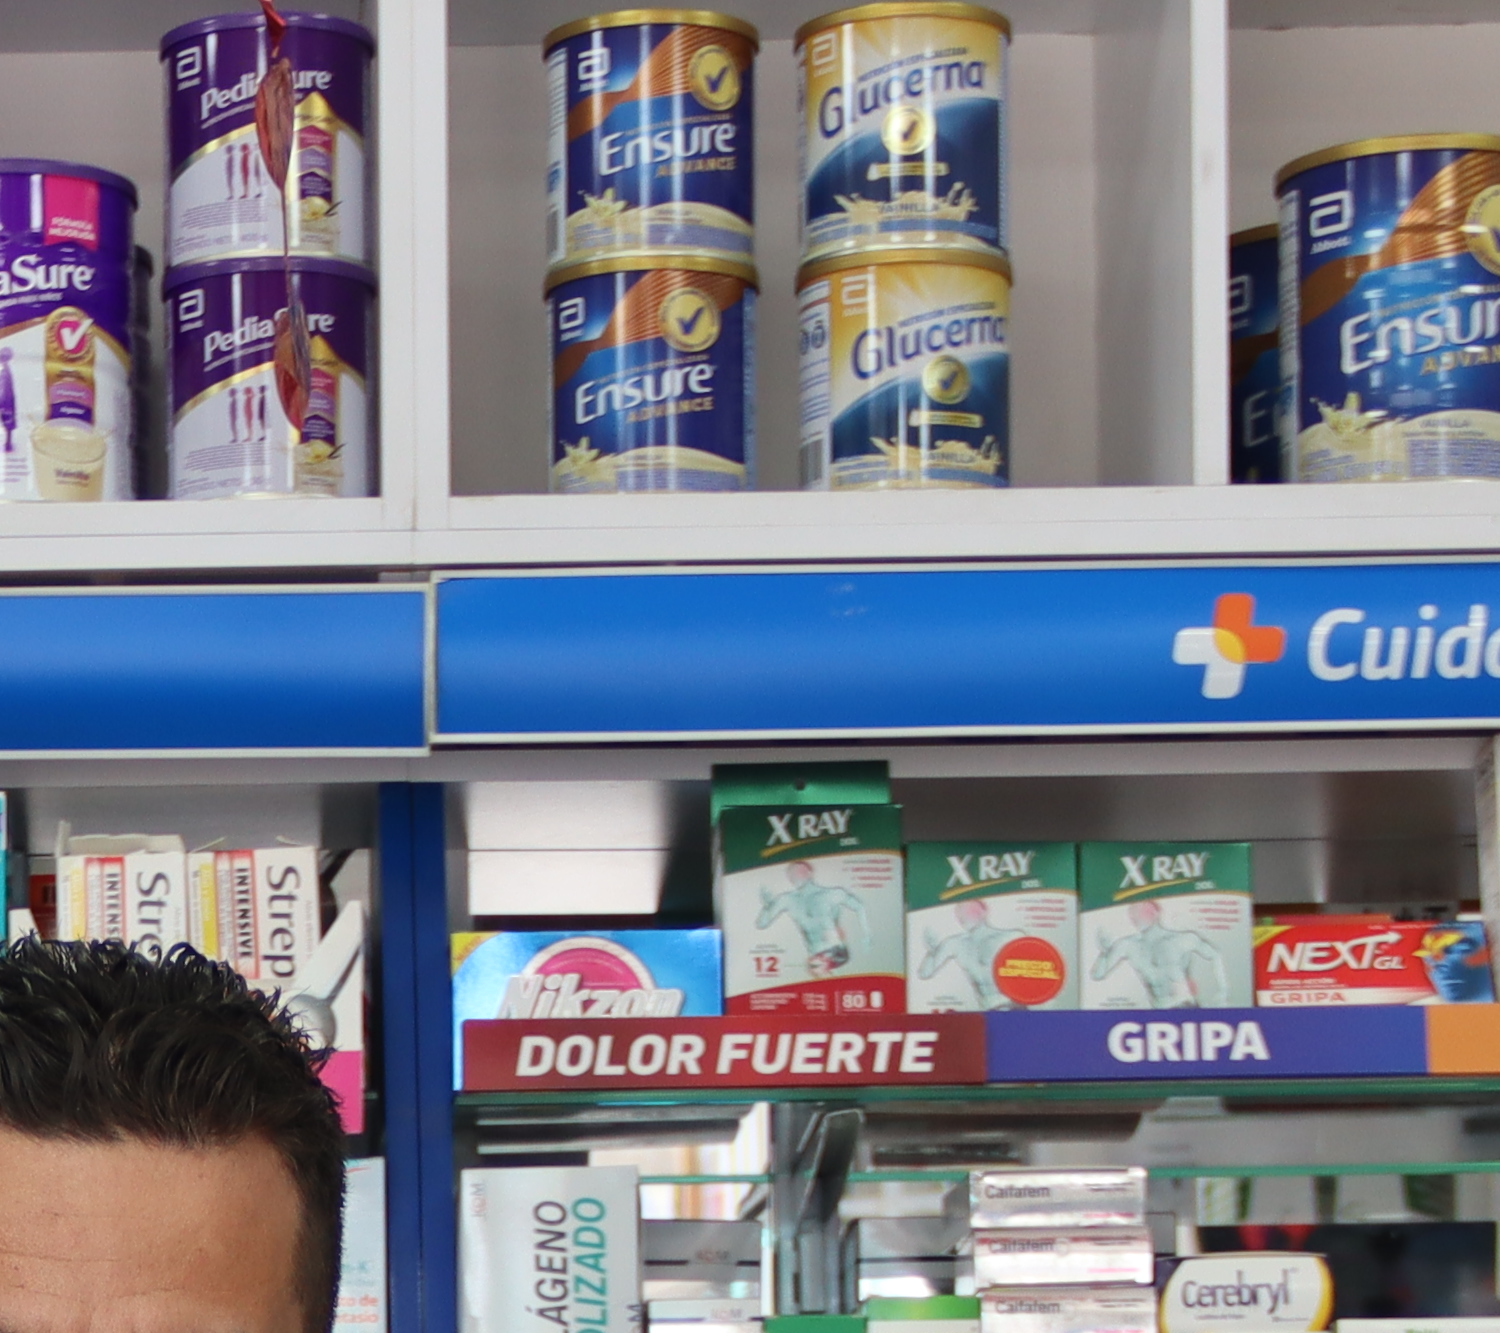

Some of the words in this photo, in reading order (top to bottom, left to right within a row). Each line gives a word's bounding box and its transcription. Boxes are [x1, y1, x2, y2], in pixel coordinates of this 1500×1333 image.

[819, 61, 986, 139] Glucerna
[600, 118, 738, 176] Ensure
[575, 360, 715, 425] Ensure
[514, 1033, 706, 1078] DOLOR
[715, 1030, 940, 1075] FUERTE
[1106, 1020, 1270, 1063] GRIPA
[1180, 1268, 1290, 1315] Cerebryl
